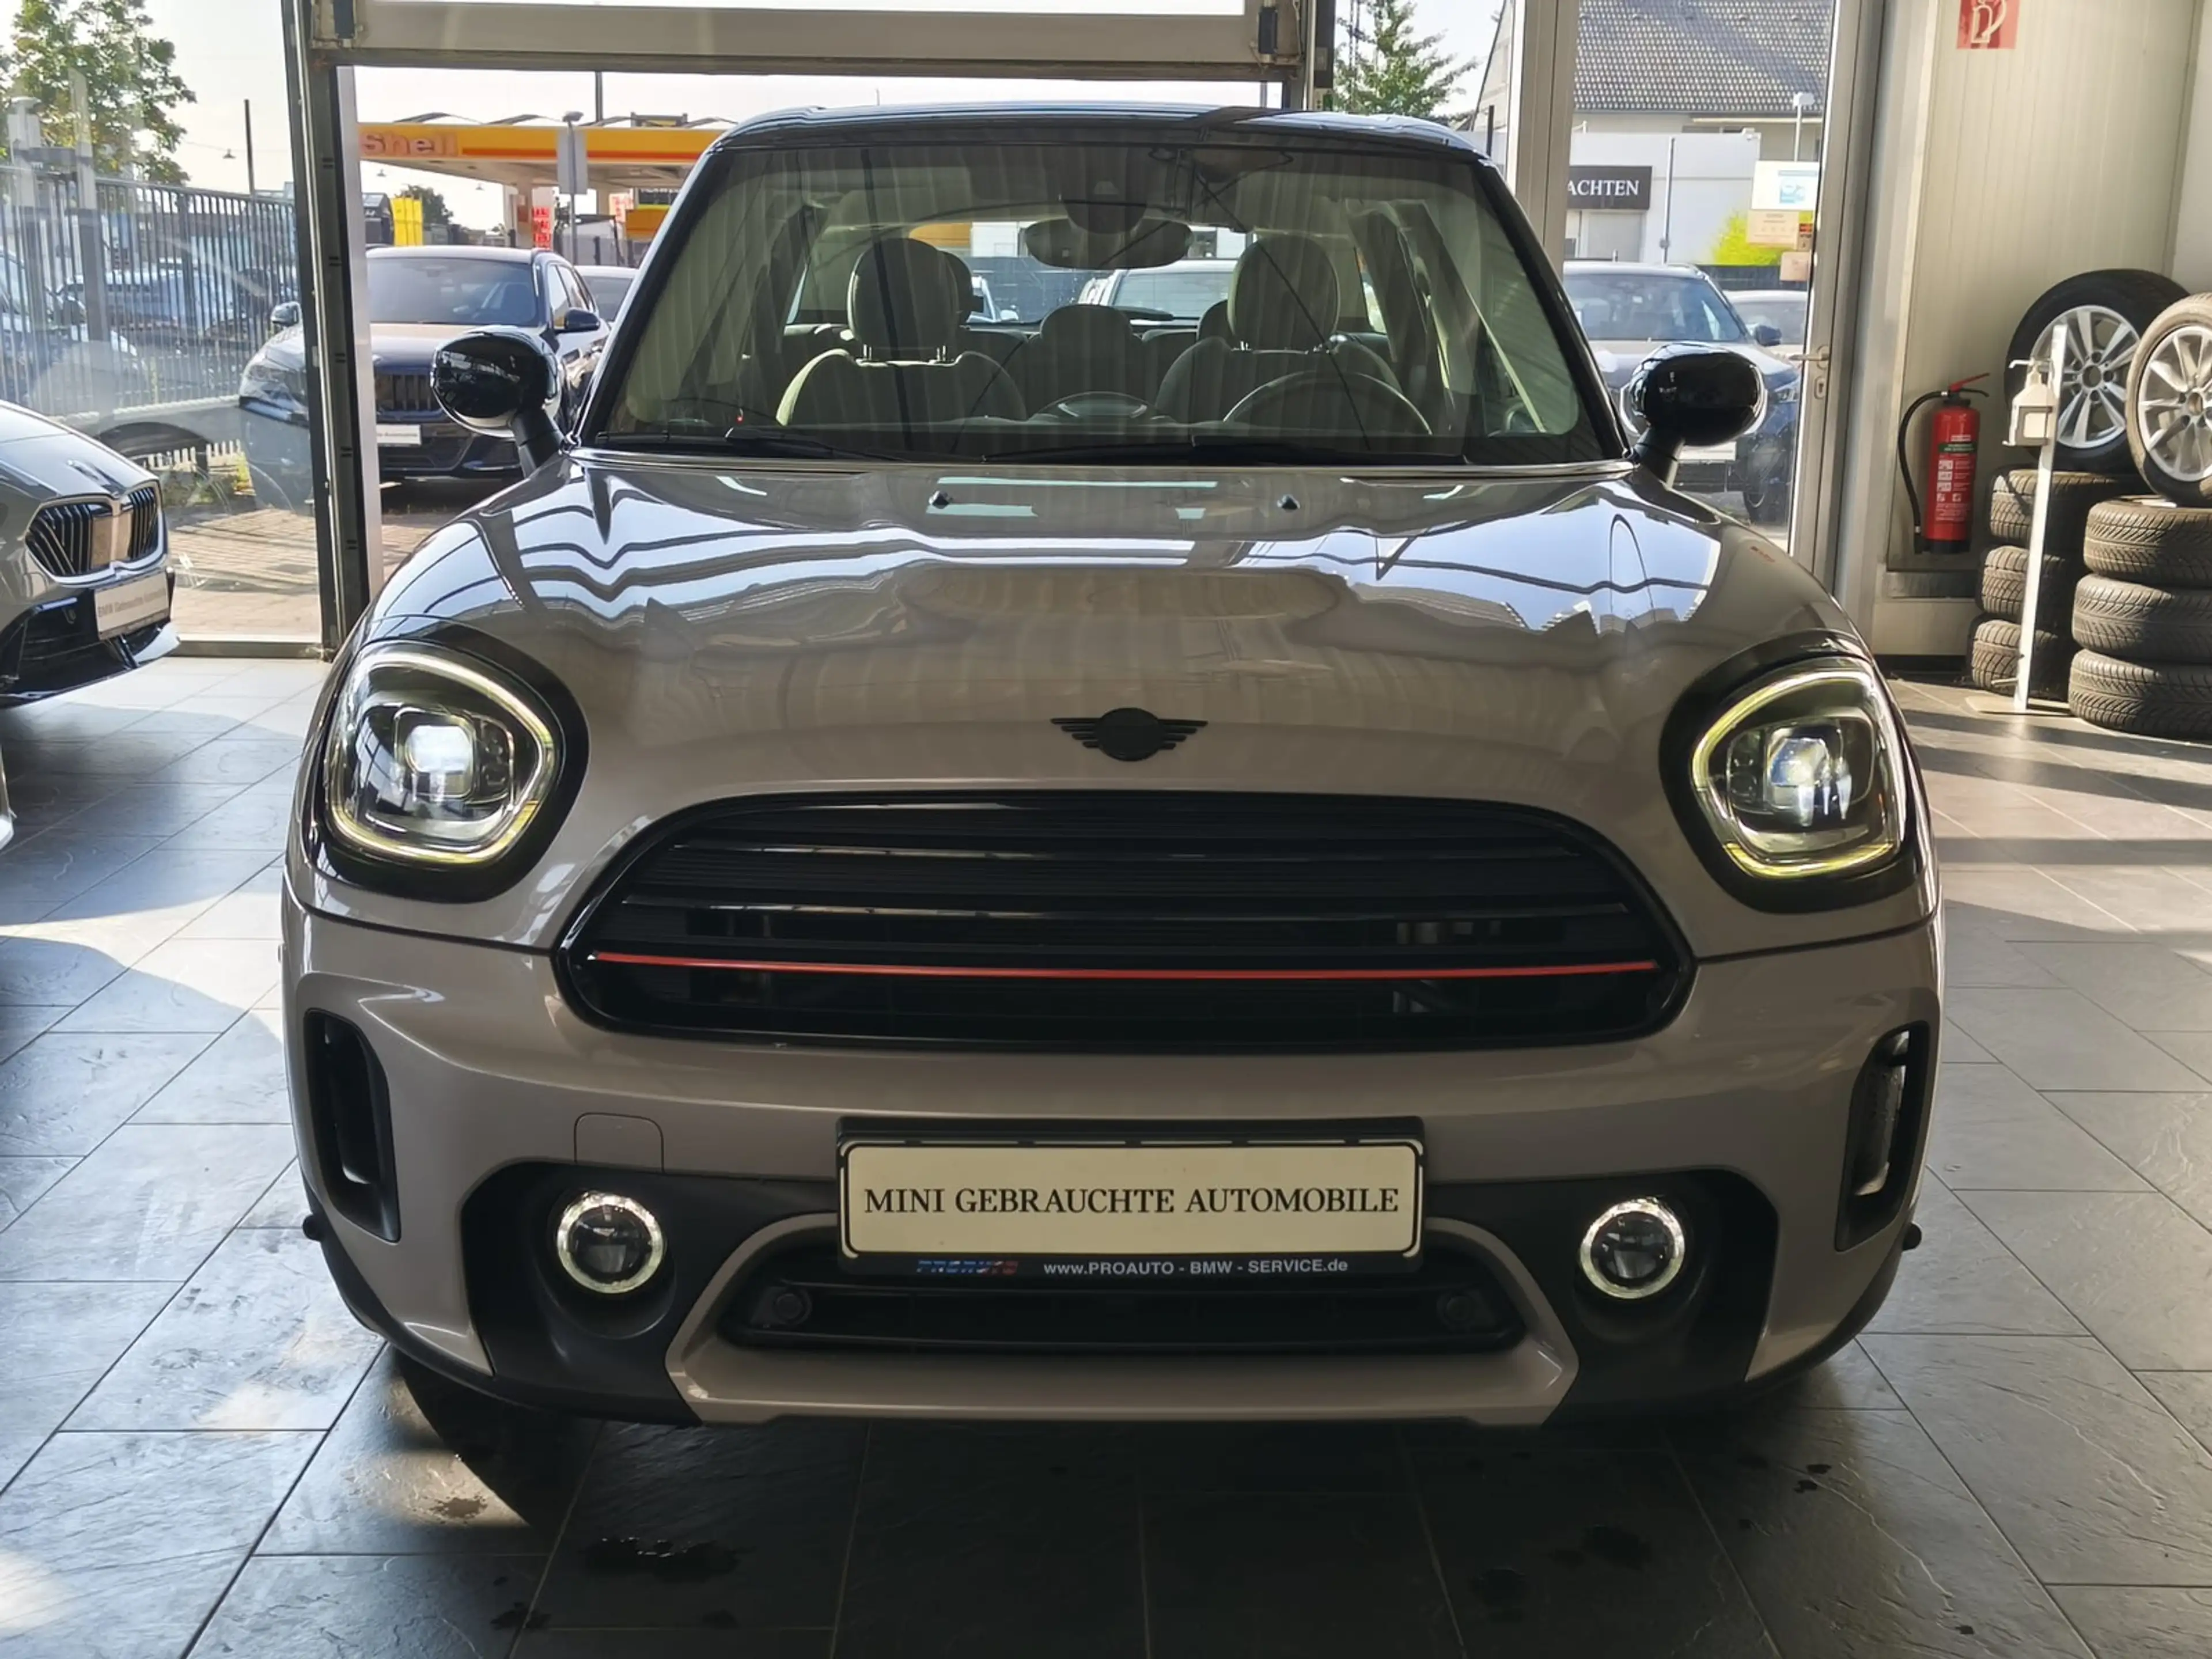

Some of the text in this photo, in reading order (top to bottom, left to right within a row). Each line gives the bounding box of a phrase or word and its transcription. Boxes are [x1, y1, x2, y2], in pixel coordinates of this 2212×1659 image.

[360, 131, 459, 157] Shell
[864, 1187, 1399, 1214] MINI GEBRAUCHTE AUTOMOBILE
[1043, 1261, 1175, 1275] www.PROAUTO
[1190, 1260, 1233, 1275] BMW
[1247, 1258, 1349, 1274] SERVICE.de
